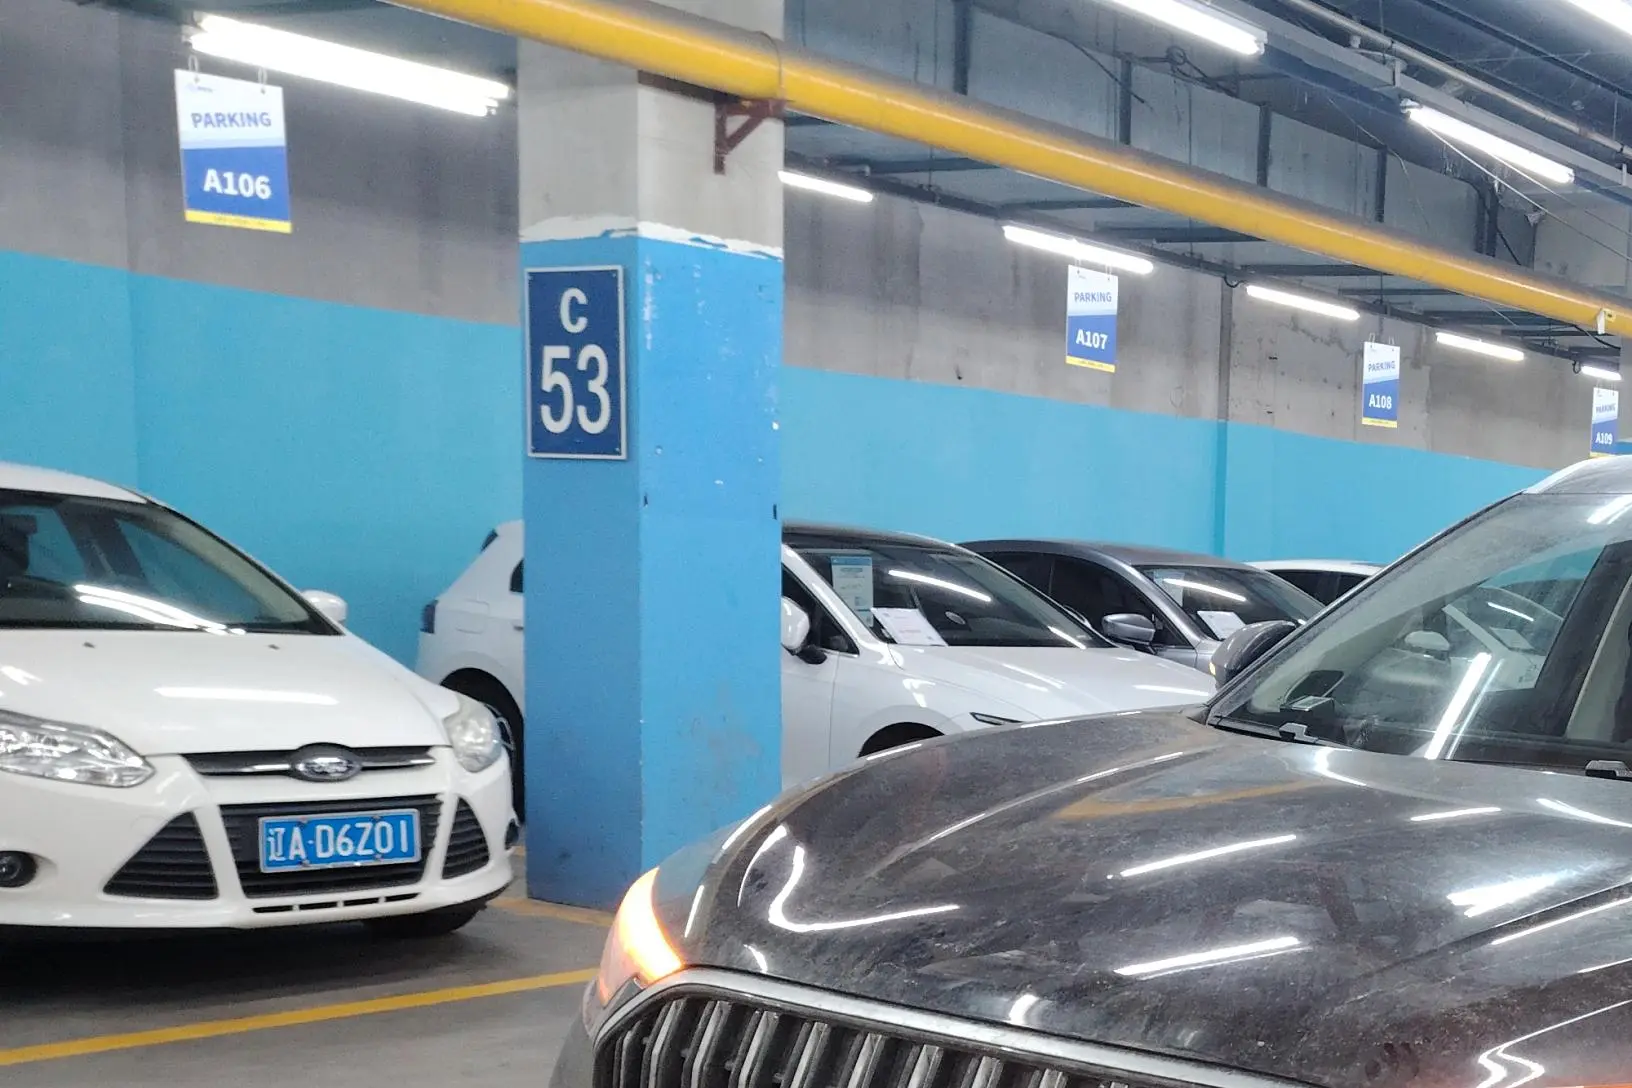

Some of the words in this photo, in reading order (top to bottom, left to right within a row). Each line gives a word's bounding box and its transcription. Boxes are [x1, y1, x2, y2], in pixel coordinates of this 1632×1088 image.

[191, 112, 272, 128] PARKING
[203, 168, 272, 200] A106
[1074, 291, 1112, 303] PARKING
[560, 287, 588, 333] C
[1075, 329, 1108, 350] A107
[1368, 361, 1396, 372] PARKING
[540, 344, 611, 434] 53
[1368, 394, 1392, 410] A108
